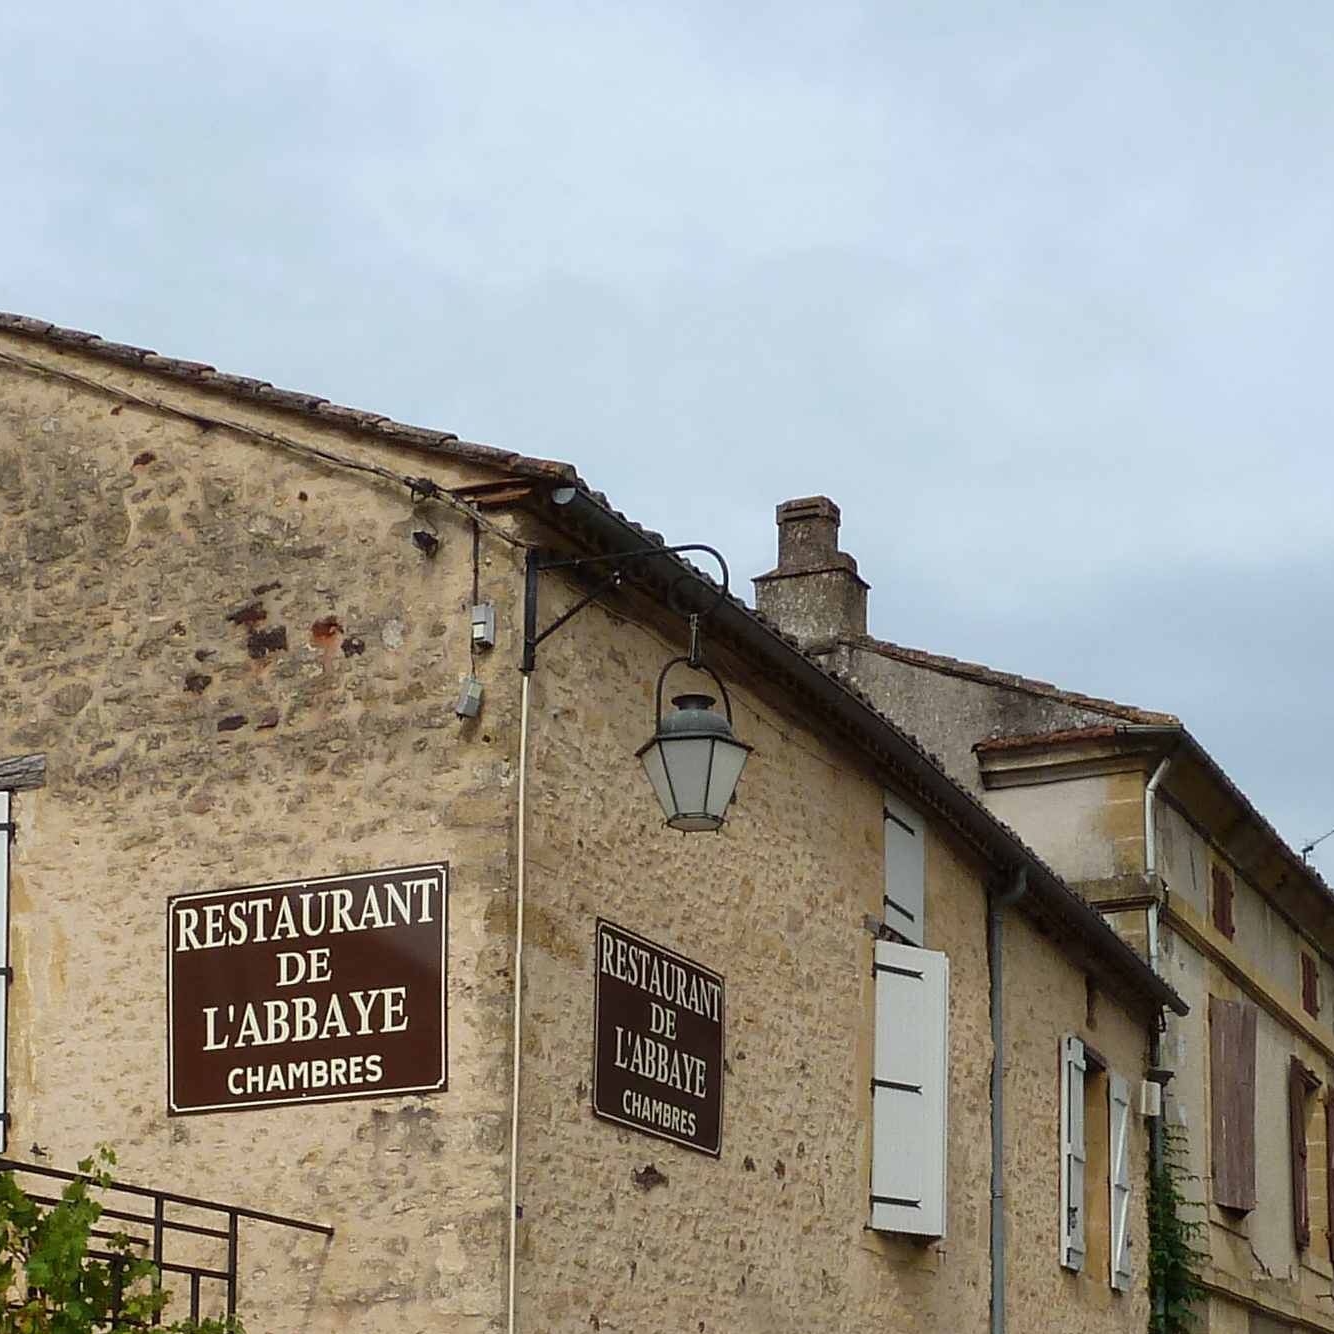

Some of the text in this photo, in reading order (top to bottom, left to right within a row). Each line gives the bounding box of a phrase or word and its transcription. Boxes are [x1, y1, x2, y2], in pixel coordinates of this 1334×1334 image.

[175, 878, 438, 951] RESTAURANT
[275, 948, 332, 988] DE
[600, 932, 721, 1024] RESTAURANT
[203, 987, 408, 1051] L'ABBAYE
[649, 1002, 677, 1042] DE
[227, 1054, 383, 1095] CHAMBRES
[614, 1026, 707, 1099] L'ABBAYE
[622, 1092, 696, 1138] CHAMBRES
